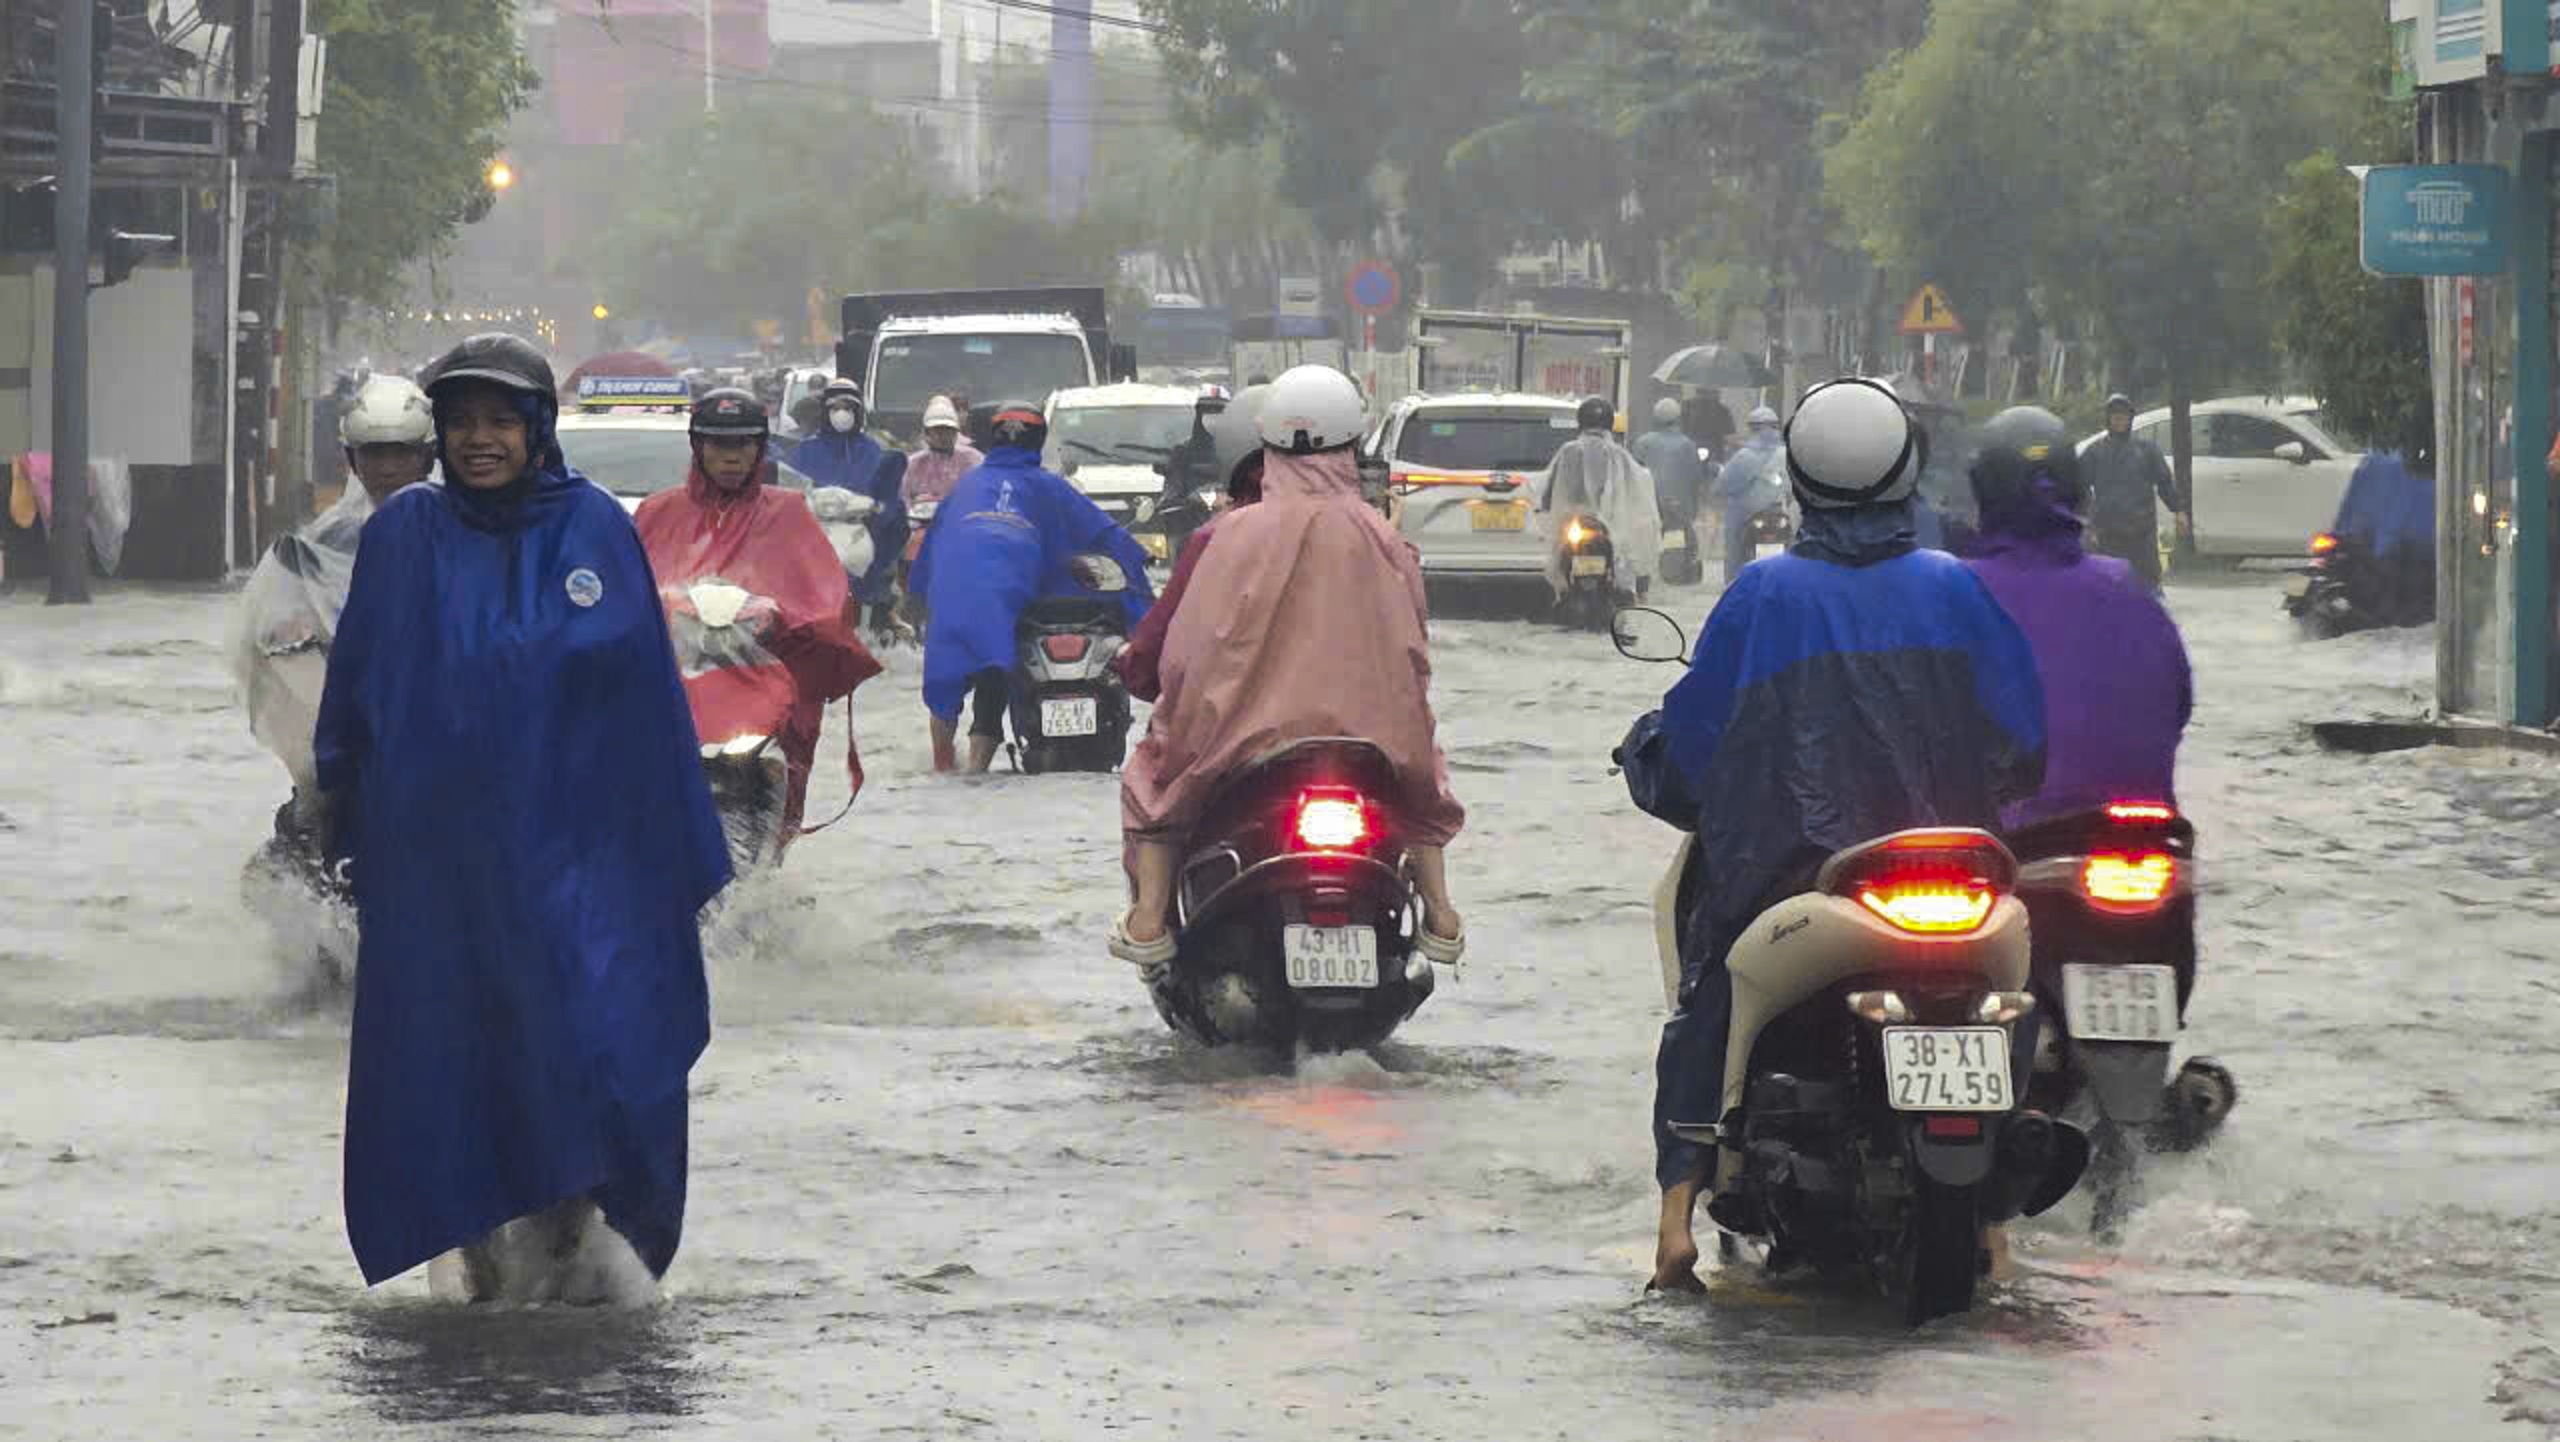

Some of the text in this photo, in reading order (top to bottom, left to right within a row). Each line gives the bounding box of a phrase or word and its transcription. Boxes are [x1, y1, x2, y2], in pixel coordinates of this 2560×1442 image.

[1300, 928, 1360, 954] 43-H1
[1292, 957, 1371, 983] 080.02
[1903, 1033, 1986, 1068] 38-X1
[1897, 1071, 2002, 1105] 274.59
